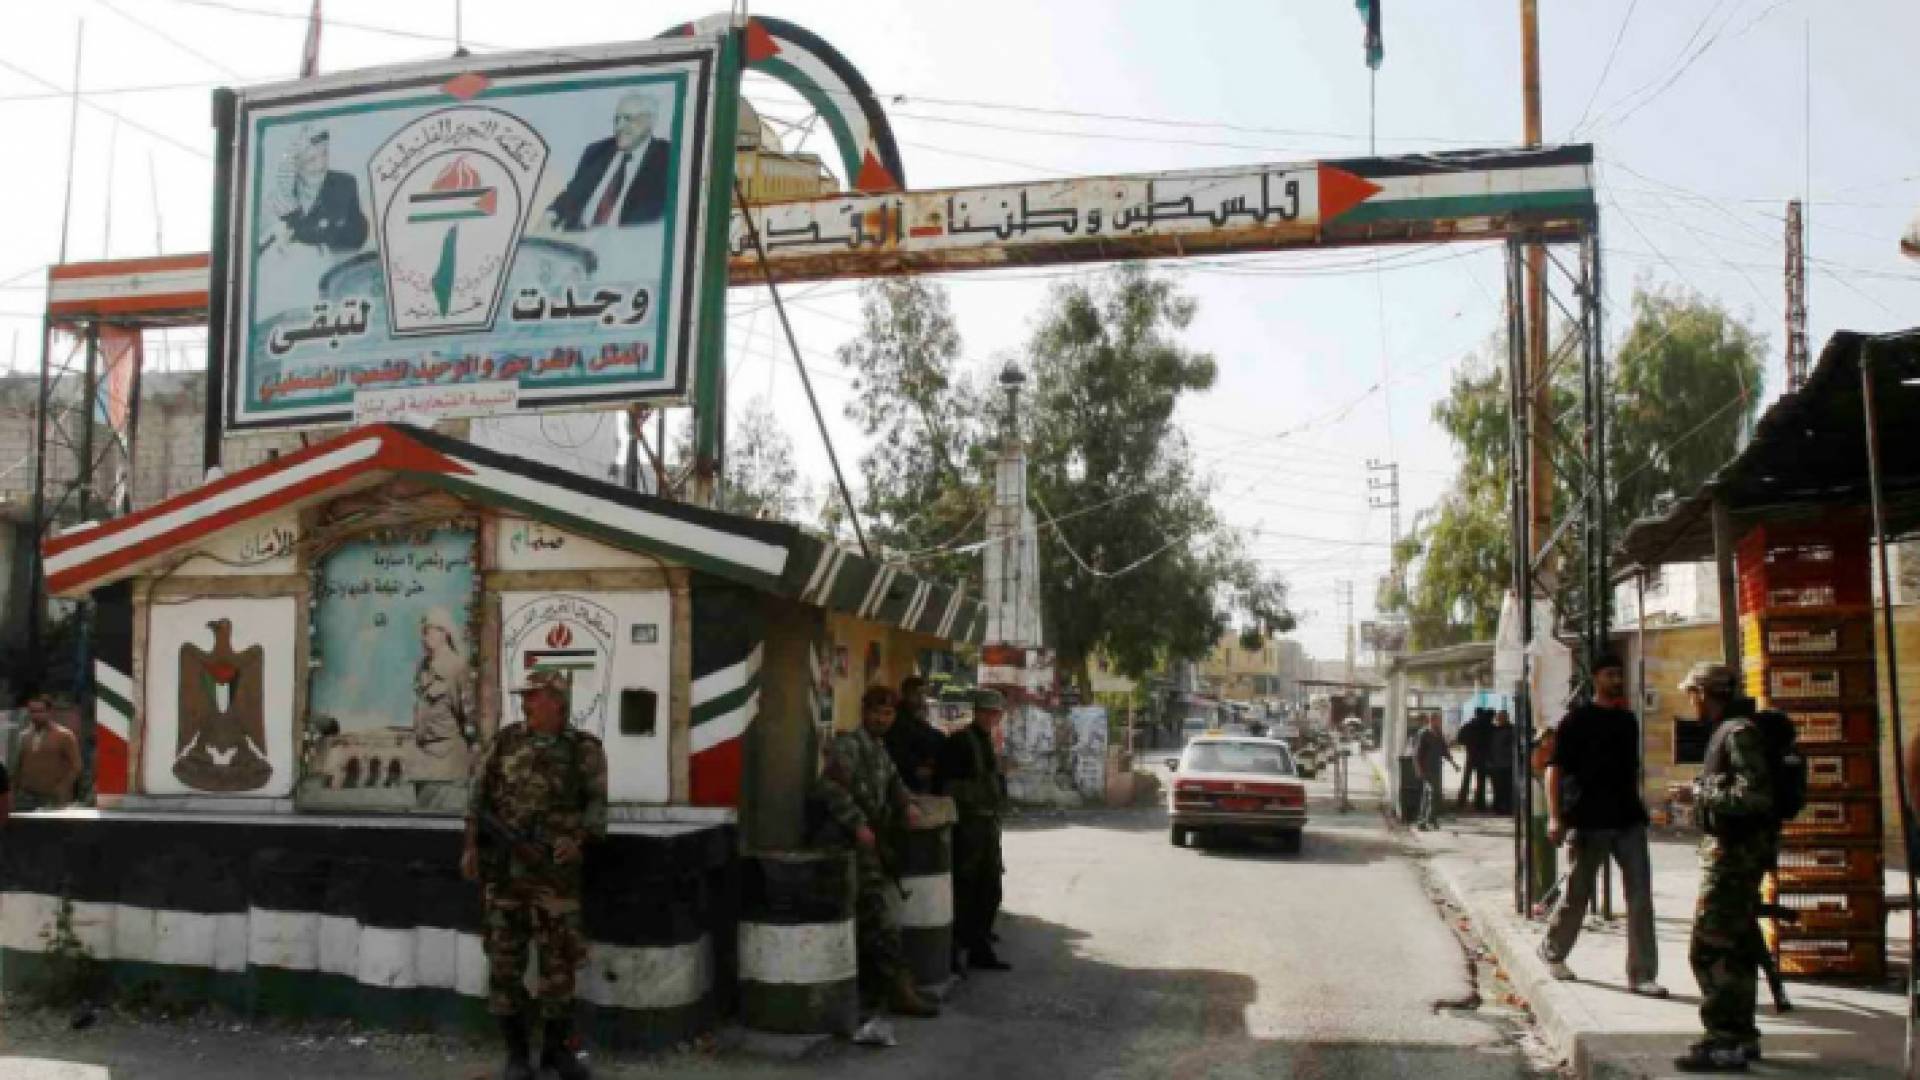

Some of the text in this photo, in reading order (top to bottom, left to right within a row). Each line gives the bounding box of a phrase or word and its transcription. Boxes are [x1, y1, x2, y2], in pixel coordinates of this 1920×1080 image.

[947, 188, 1103, 240] وطننا
[1112, 171, 1300, 236] فلسطين
[269, 286, 649, 355] وجدت لتبقى
[259, 364, 348, 403] الفلسطيني
